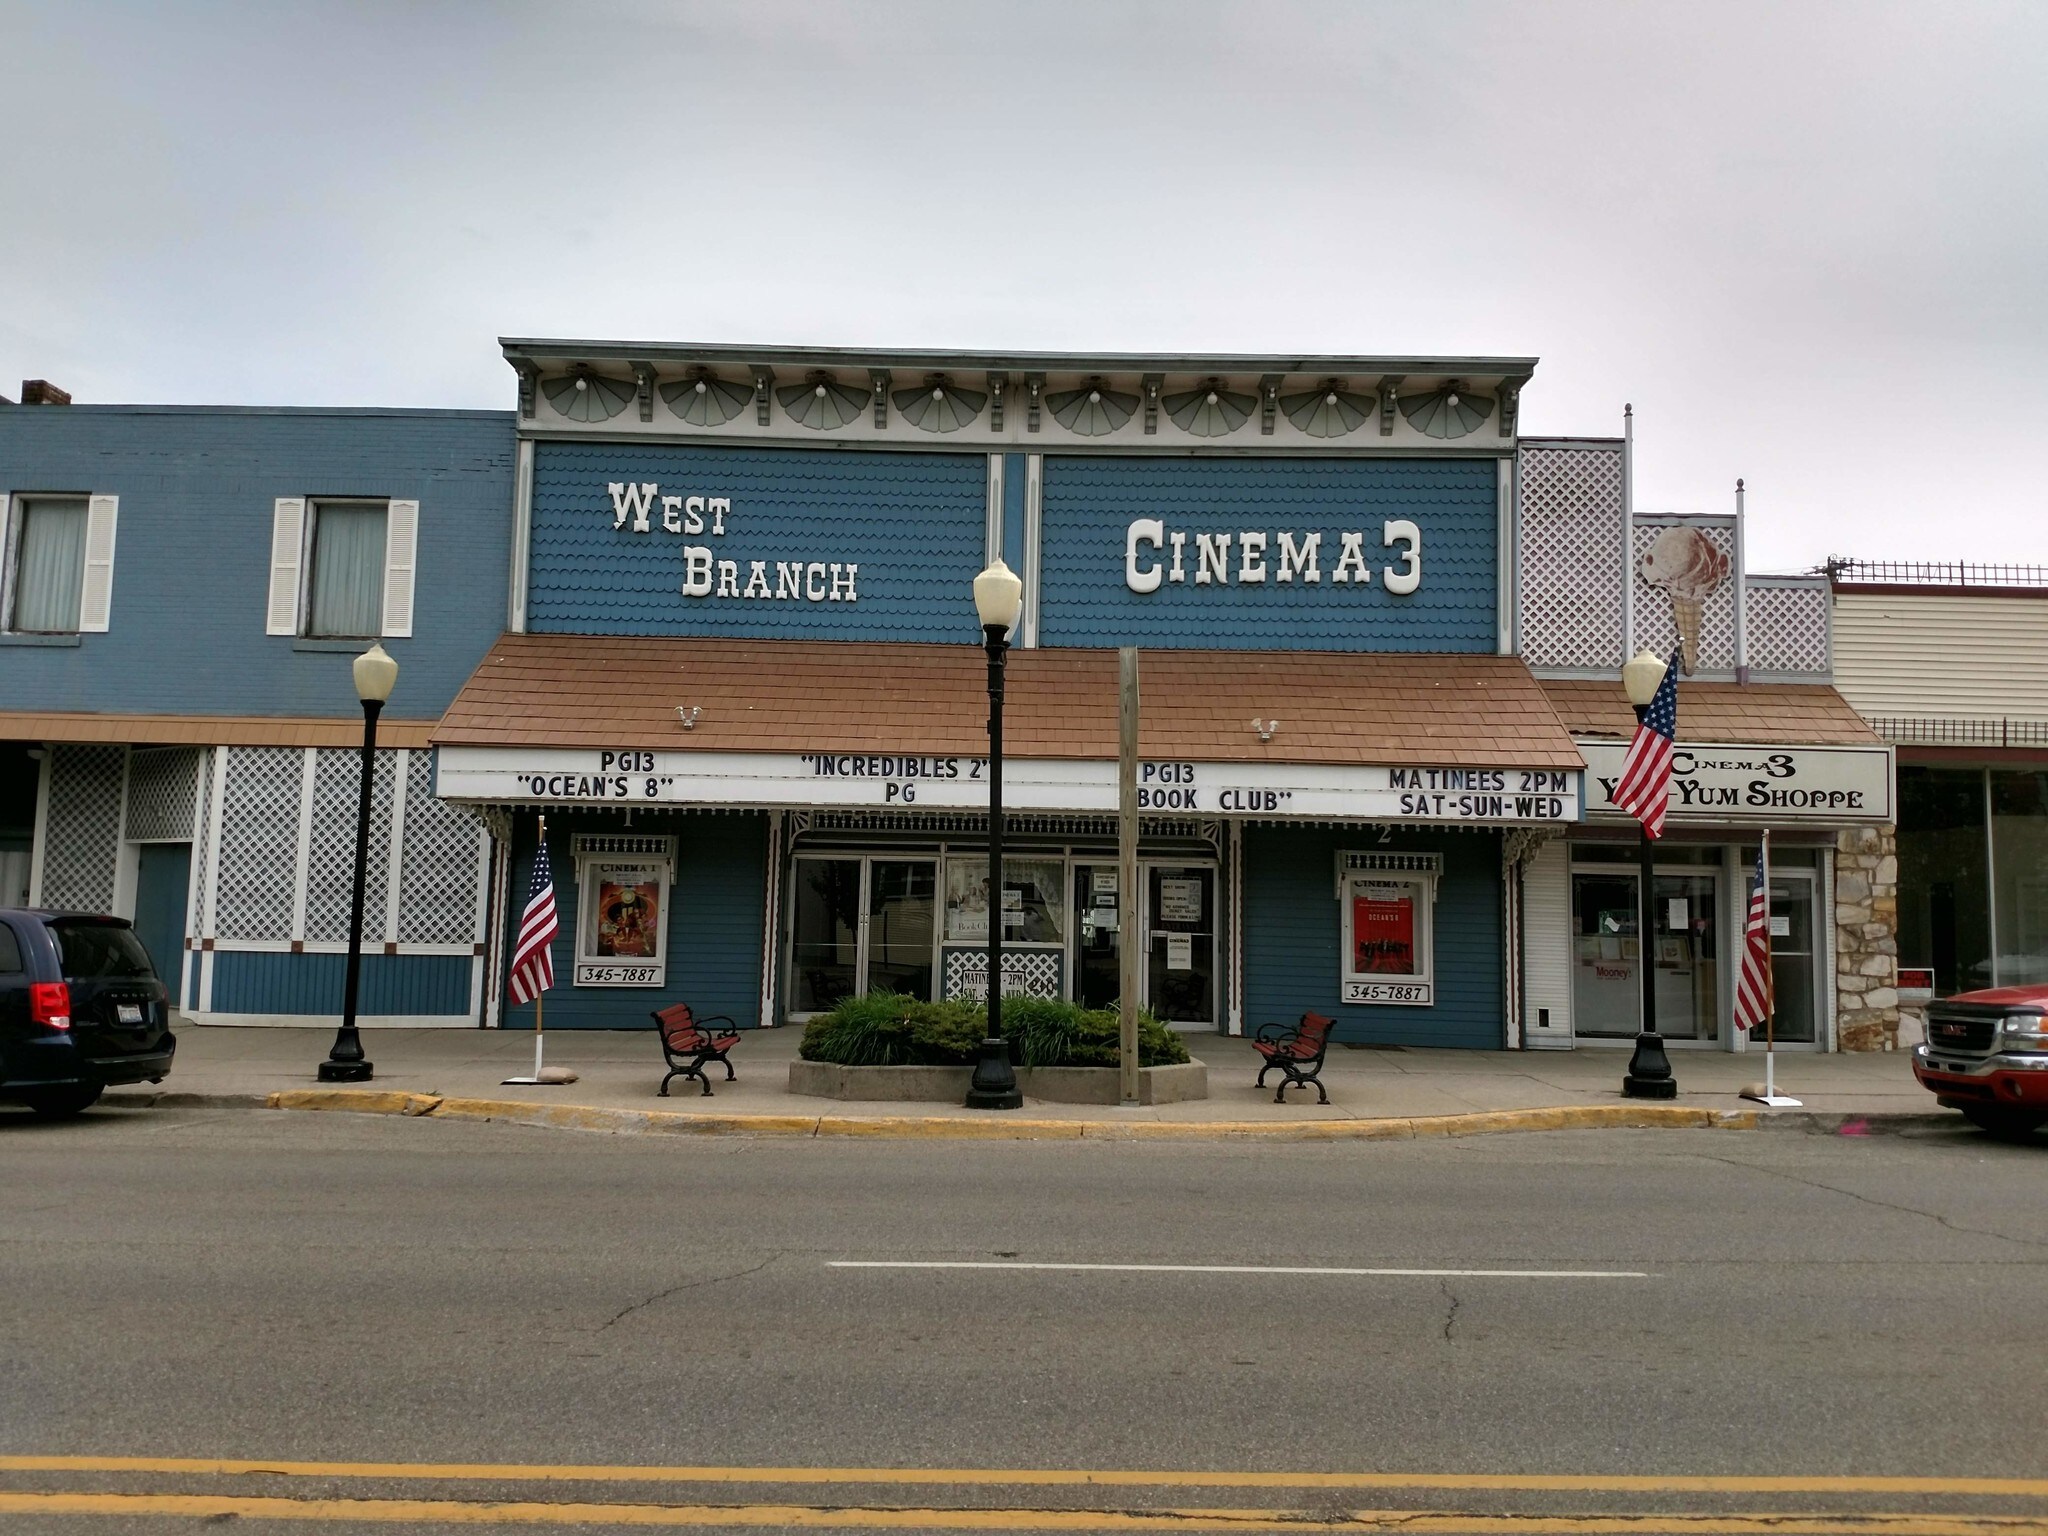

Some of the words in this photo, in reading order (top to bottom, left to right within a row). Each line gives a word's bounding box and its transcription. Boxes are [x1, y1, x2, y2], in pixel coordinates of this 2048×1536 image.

[608, 482, 730, 535] WEST
[1125, 518, 1370, 594] CINEMA
[1383, 519, 1421, 595] 3
[682, 546, 858, 601] BRANCH
[601, 751, 655, 772] PG13
[801, 755, 958, 778] "INCREDIBLES
[1142, 762, 1195, 783] PG13
[517, 775, 628, 797] "OCEAN'S
[644, 777, 674, 797] 8"
[885, 782, 915, 802] PG
[1389, 769, 1505, 791] MATINEES
[1519, 772, 1567, 793] 2PM
[1137, 787, 1197, 808] BOOK
[1218, 790, 1292, 811] CLUB"
[1746, 780, 1863, 808] SHOPPE
[1400, 793, 1563, 818] SAT-SUN-WED
[600, 864, 647, 872] CINEMA
[1354, 880, 1399, 888] CINEMA
[585, 968, 656, 981] 345-7887
[1008, 974, 1023, 985] 2PM
[1351, 985, 1422, 1000] 345-7887
